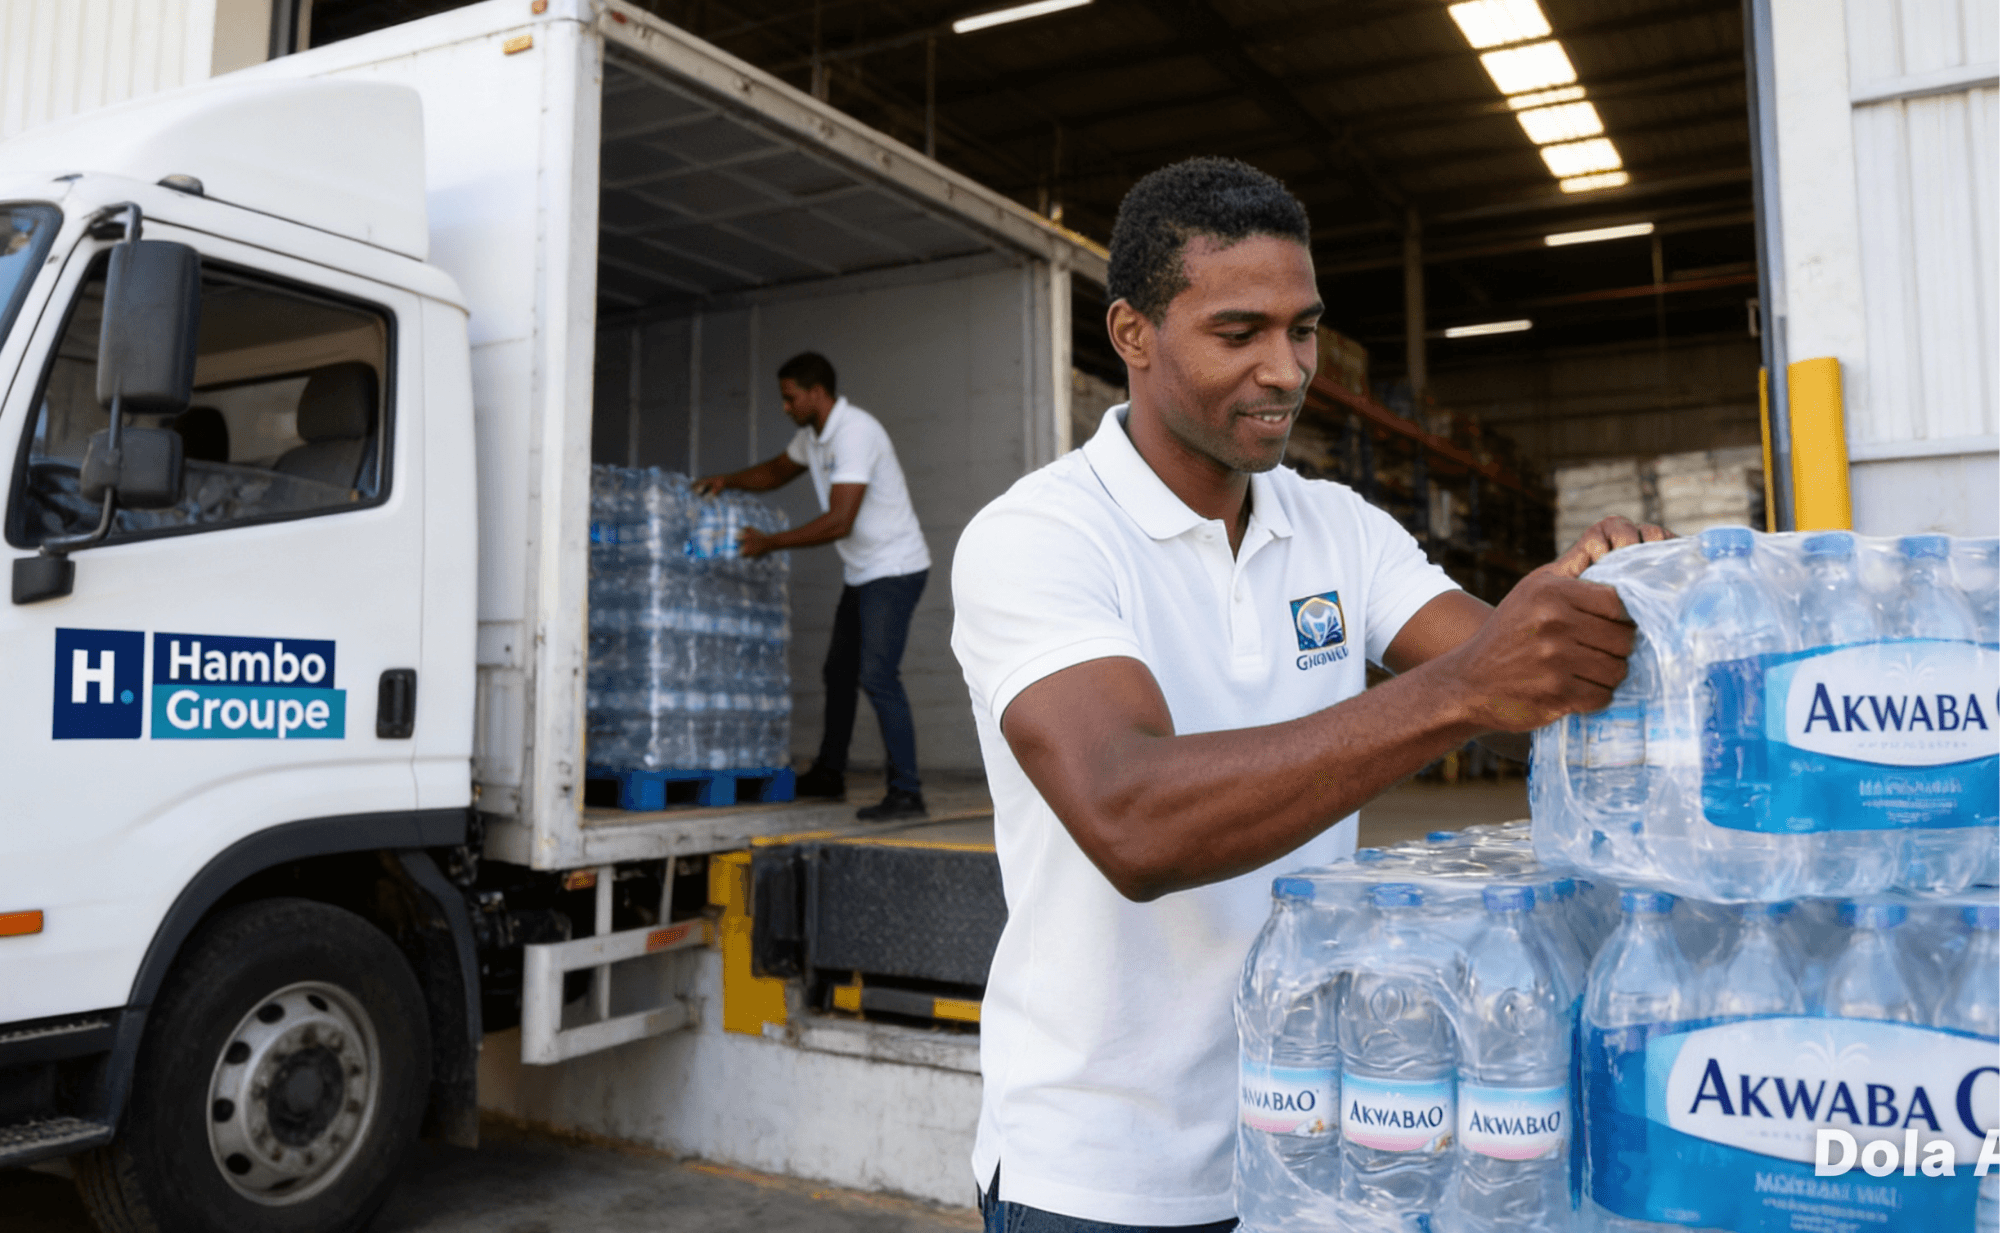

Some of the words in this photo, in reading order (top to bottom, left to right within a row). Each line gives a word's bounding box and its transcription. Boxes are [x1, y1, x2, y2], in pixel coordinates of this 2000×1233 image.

[169, 639, 327, 684] Hambo
[166, 689, 330, 740] Groupe
[1350, 1099, 1443, 1129] AKWABAO
[1469, 1109, 1560, 1136] AKWABAO
